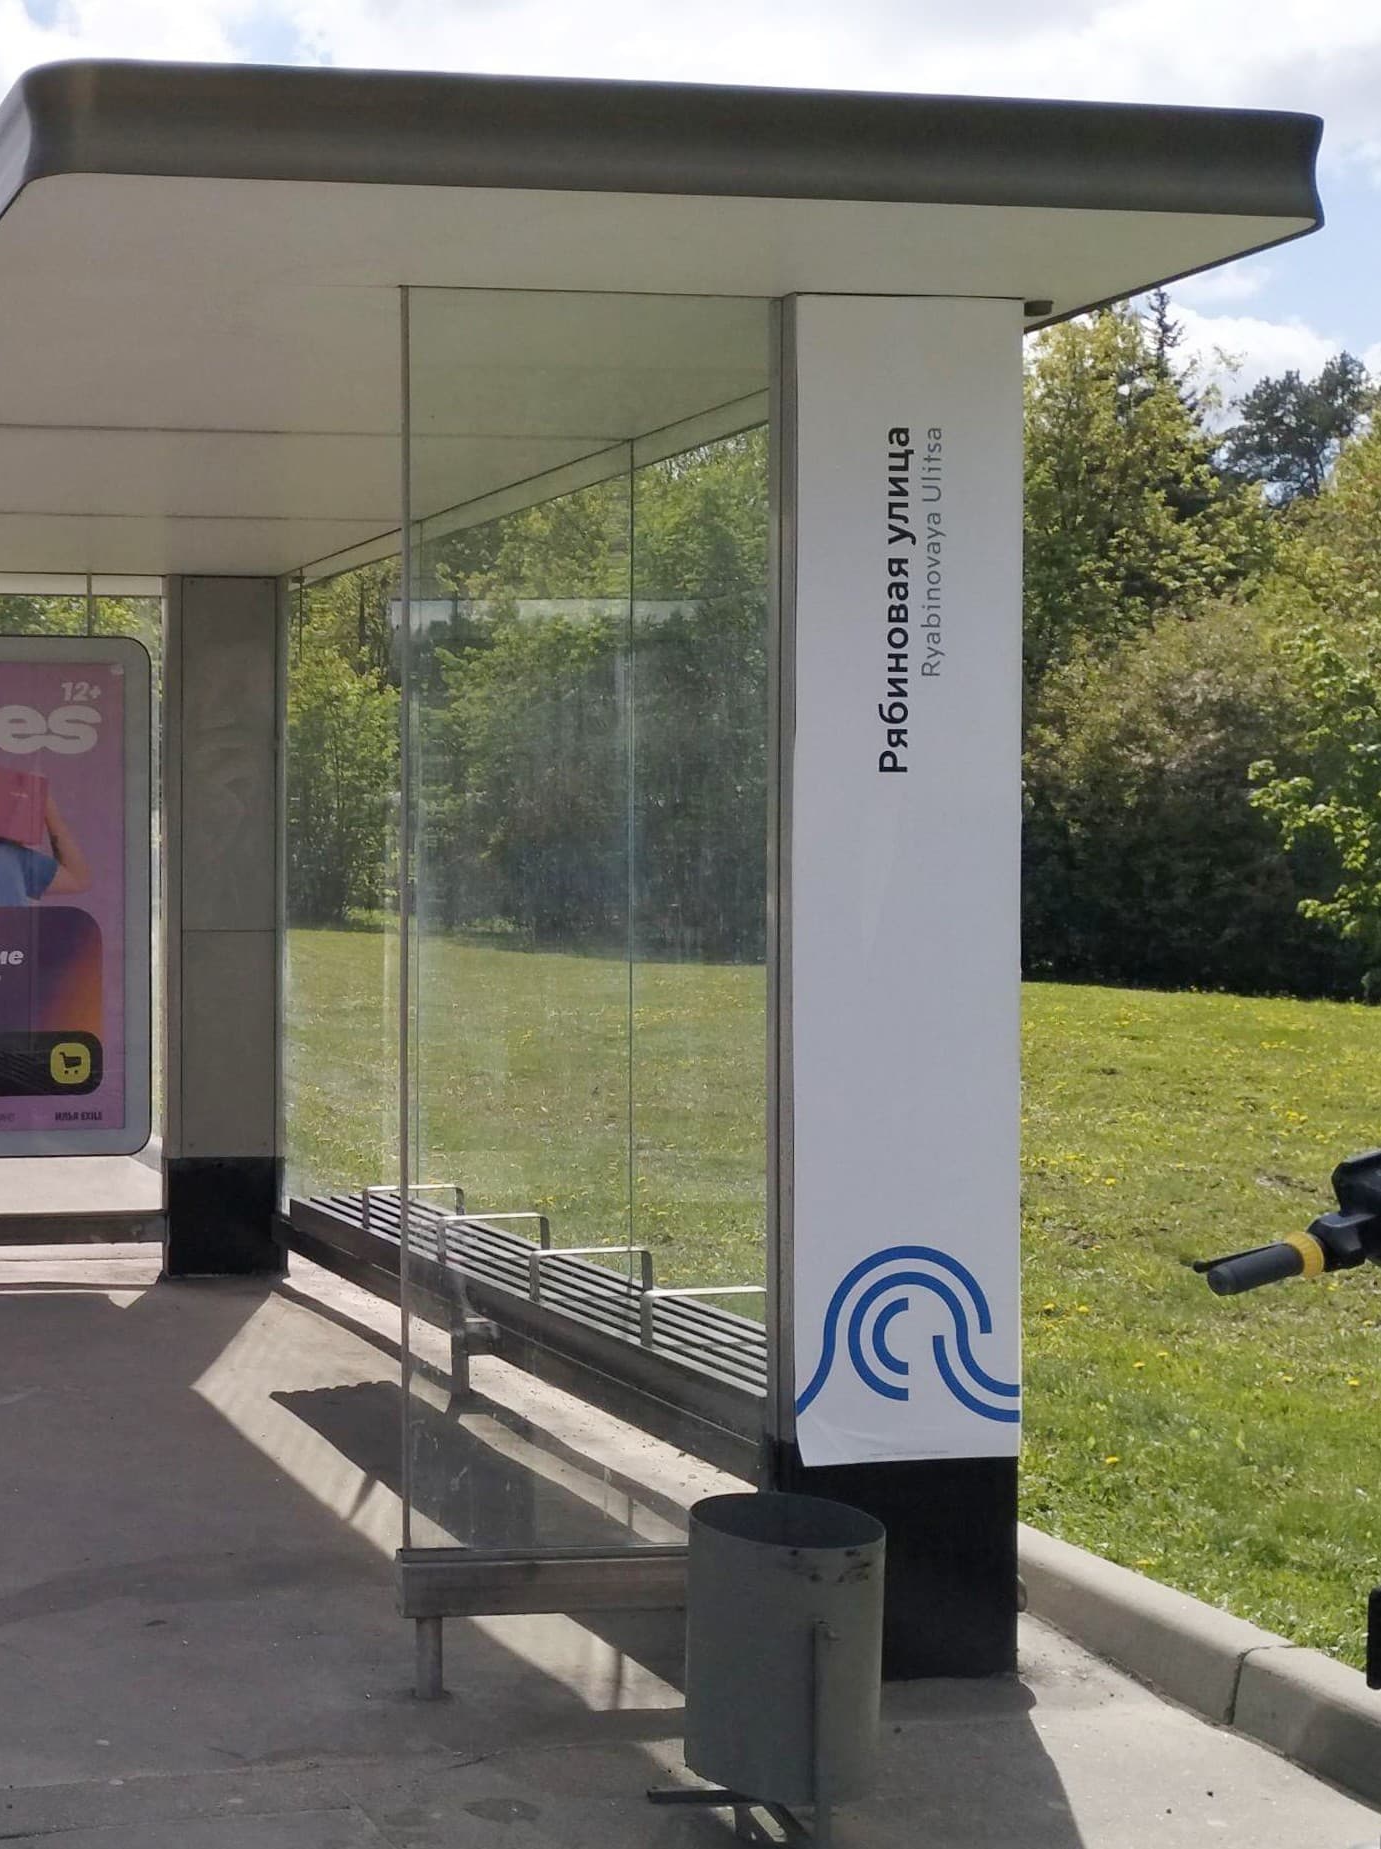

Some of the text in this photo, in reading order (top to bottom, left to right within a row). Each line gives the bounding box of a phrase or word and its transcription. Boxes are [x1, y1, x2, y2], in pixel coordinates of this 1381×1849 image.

[878, 426, 916, 773] Рябиновая улица
[920, 426, 947, 678] Ryabinovaya Ulitsa
[60, 681, 101, 702] 12+
